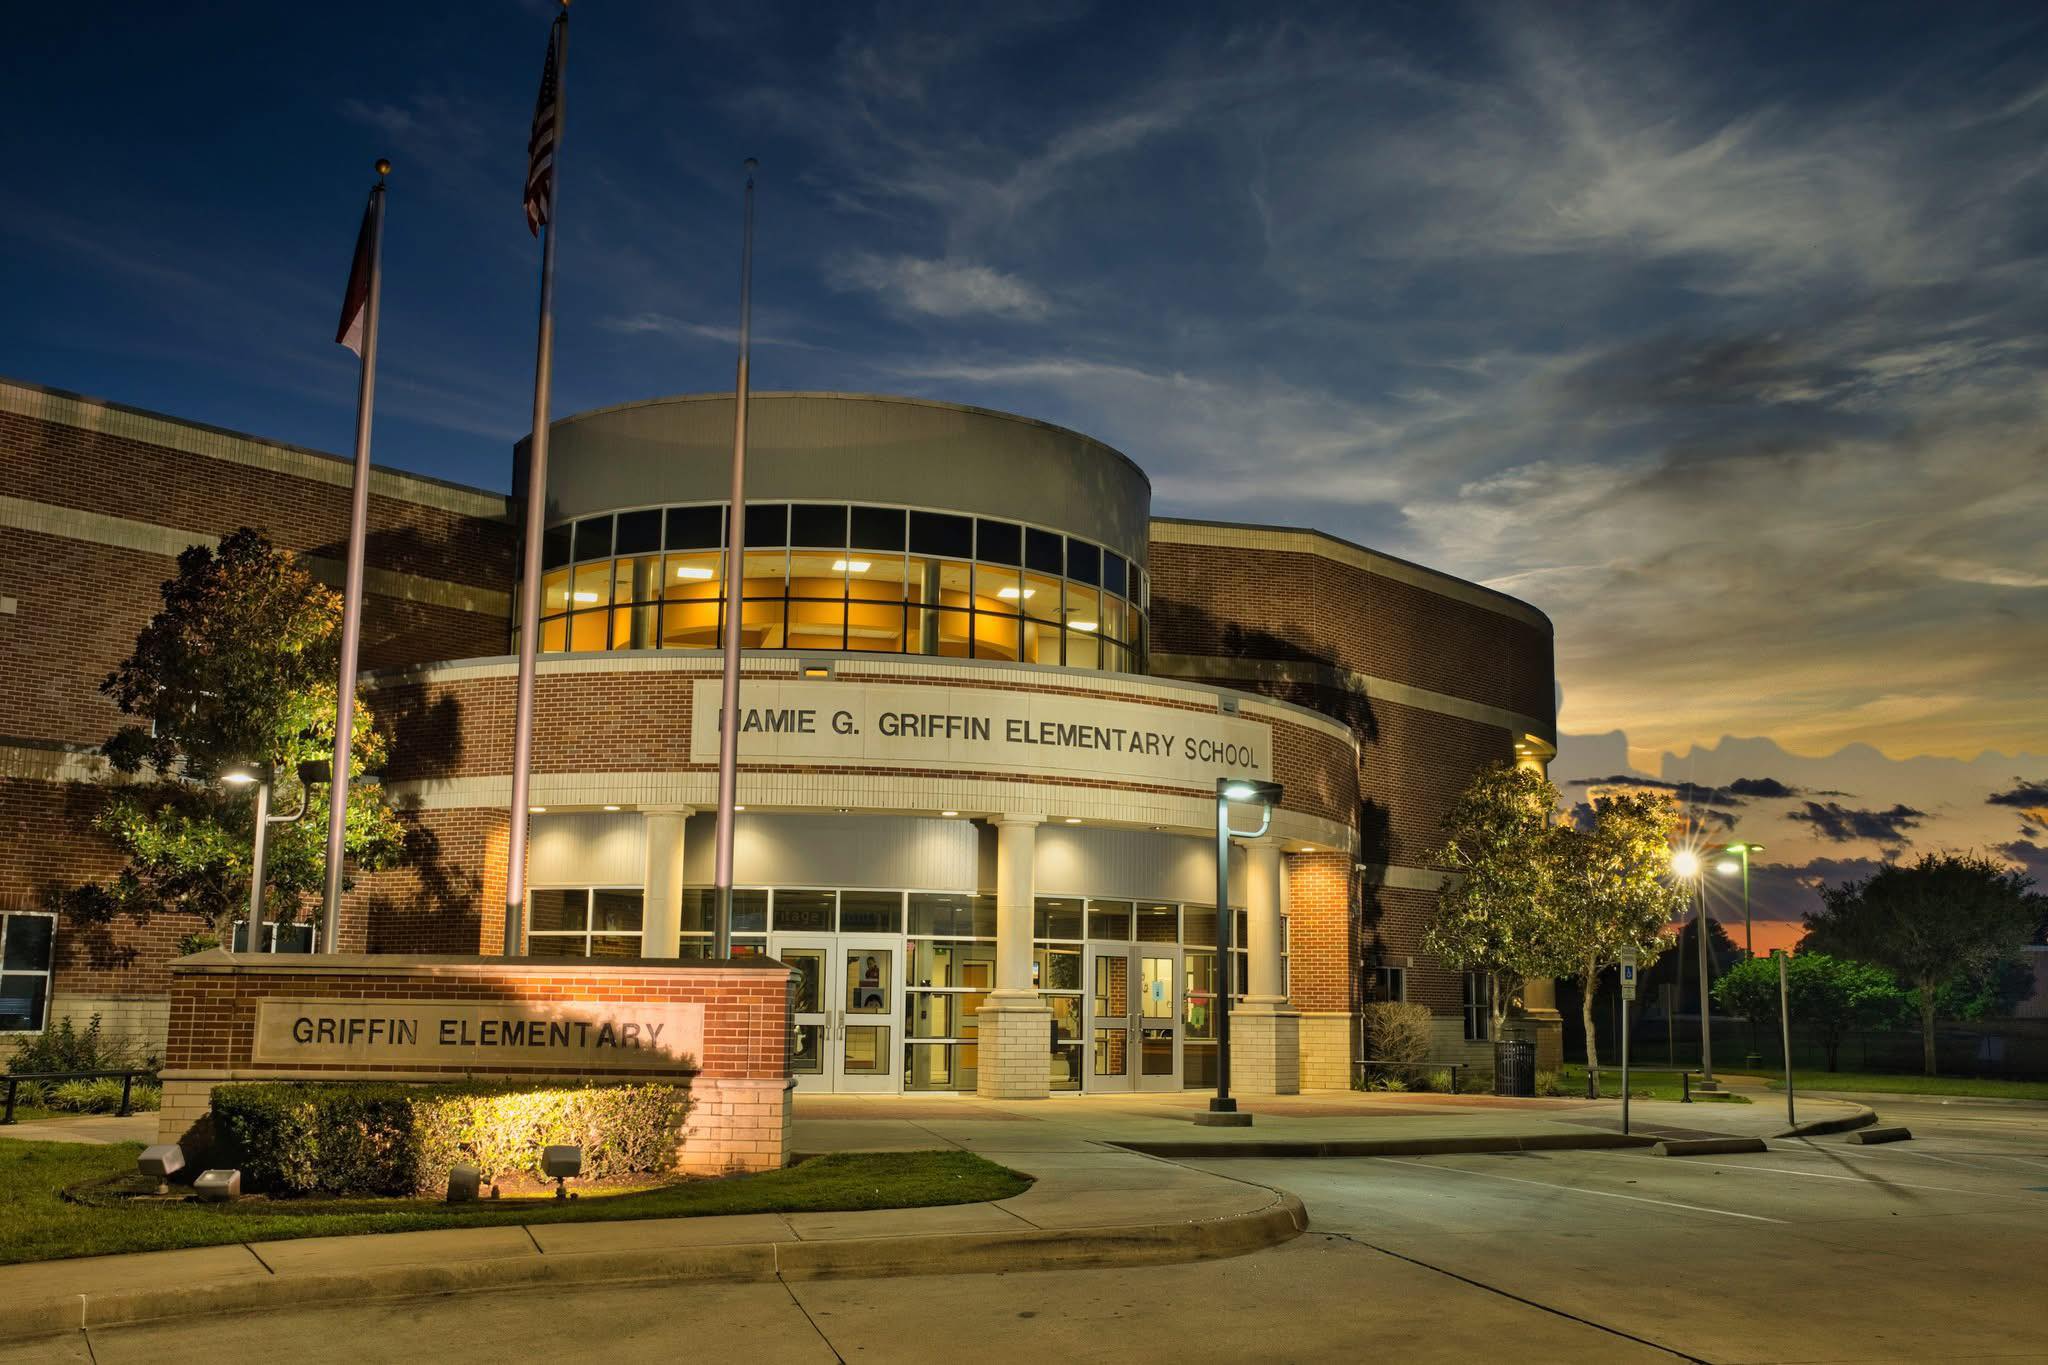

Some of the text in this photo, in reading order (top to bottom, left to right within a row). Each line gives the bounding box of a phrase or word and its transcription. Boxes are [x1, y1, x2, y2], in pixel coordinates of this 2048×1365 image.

[832, 710, 860, 735] G.
[878, 712, 991, 741] GRIFFIN
[1006, 719, 1175, 757] ELEMENTARY
[1185, 737, 1259, 769] SCHOOL
[292, 1016, 665, 1049] GRIFFIN ELEMENTARY
